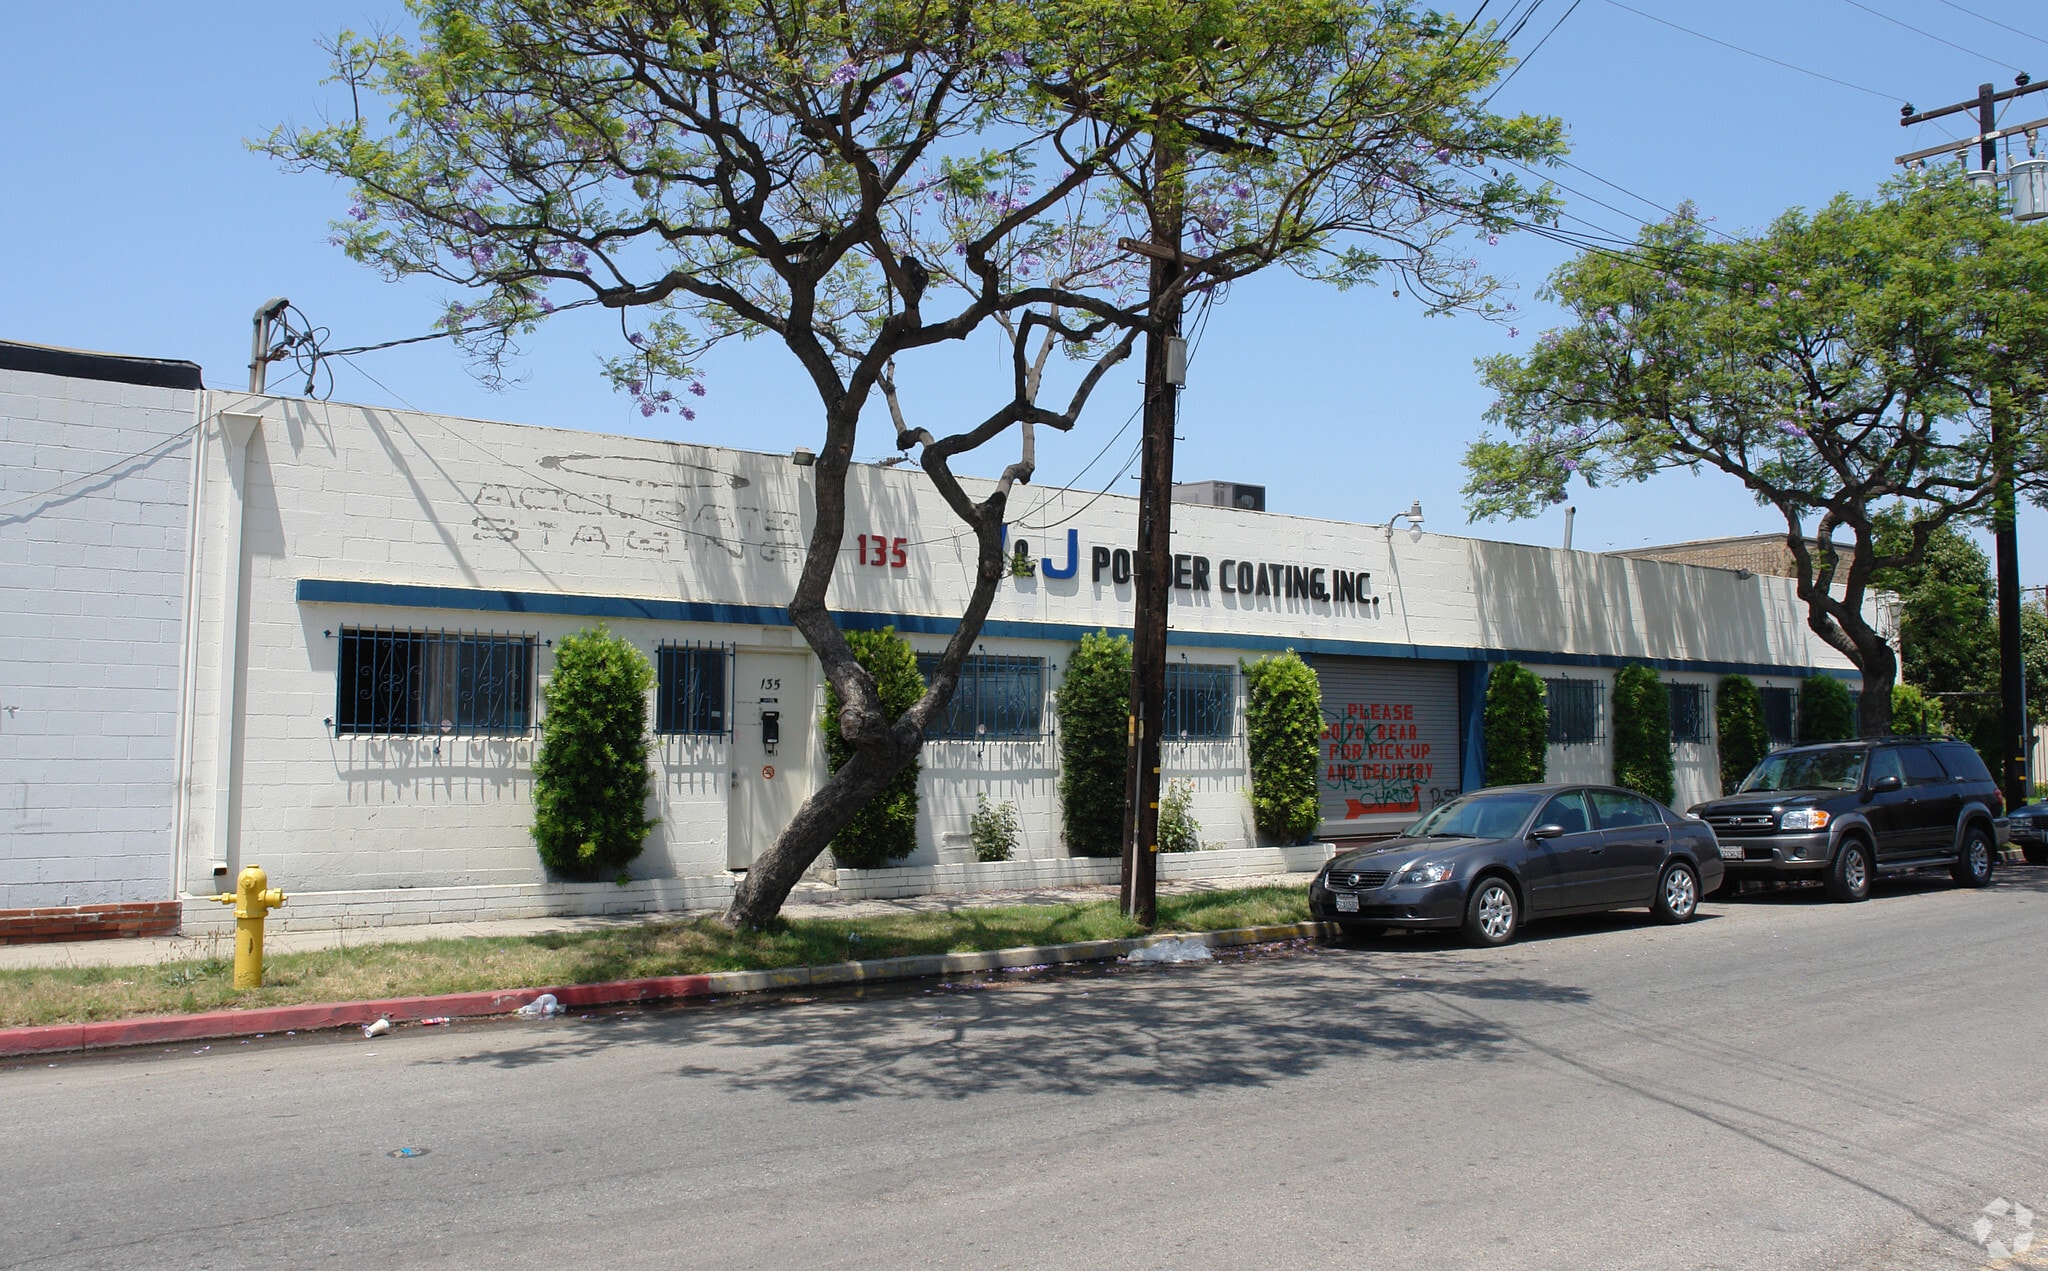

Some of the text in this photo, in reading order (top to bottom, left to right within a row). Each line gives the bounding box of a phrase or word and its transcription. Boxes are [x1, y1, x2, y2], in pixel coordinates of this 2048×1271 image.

[857, 534, 908, 568] 135
[1041, 528, 1079, 579] J
[1091, 545, 1210, 591] POER
[760, 678, 781, 690] 135
[1347, 703, 1414, 721] PLEASE
[1377, 723, 1417, 740] REAR
[1329, 743, 1431, 761] FOR PICK-UP
[1327, 763, 1433, 781] AND DELIVERY
